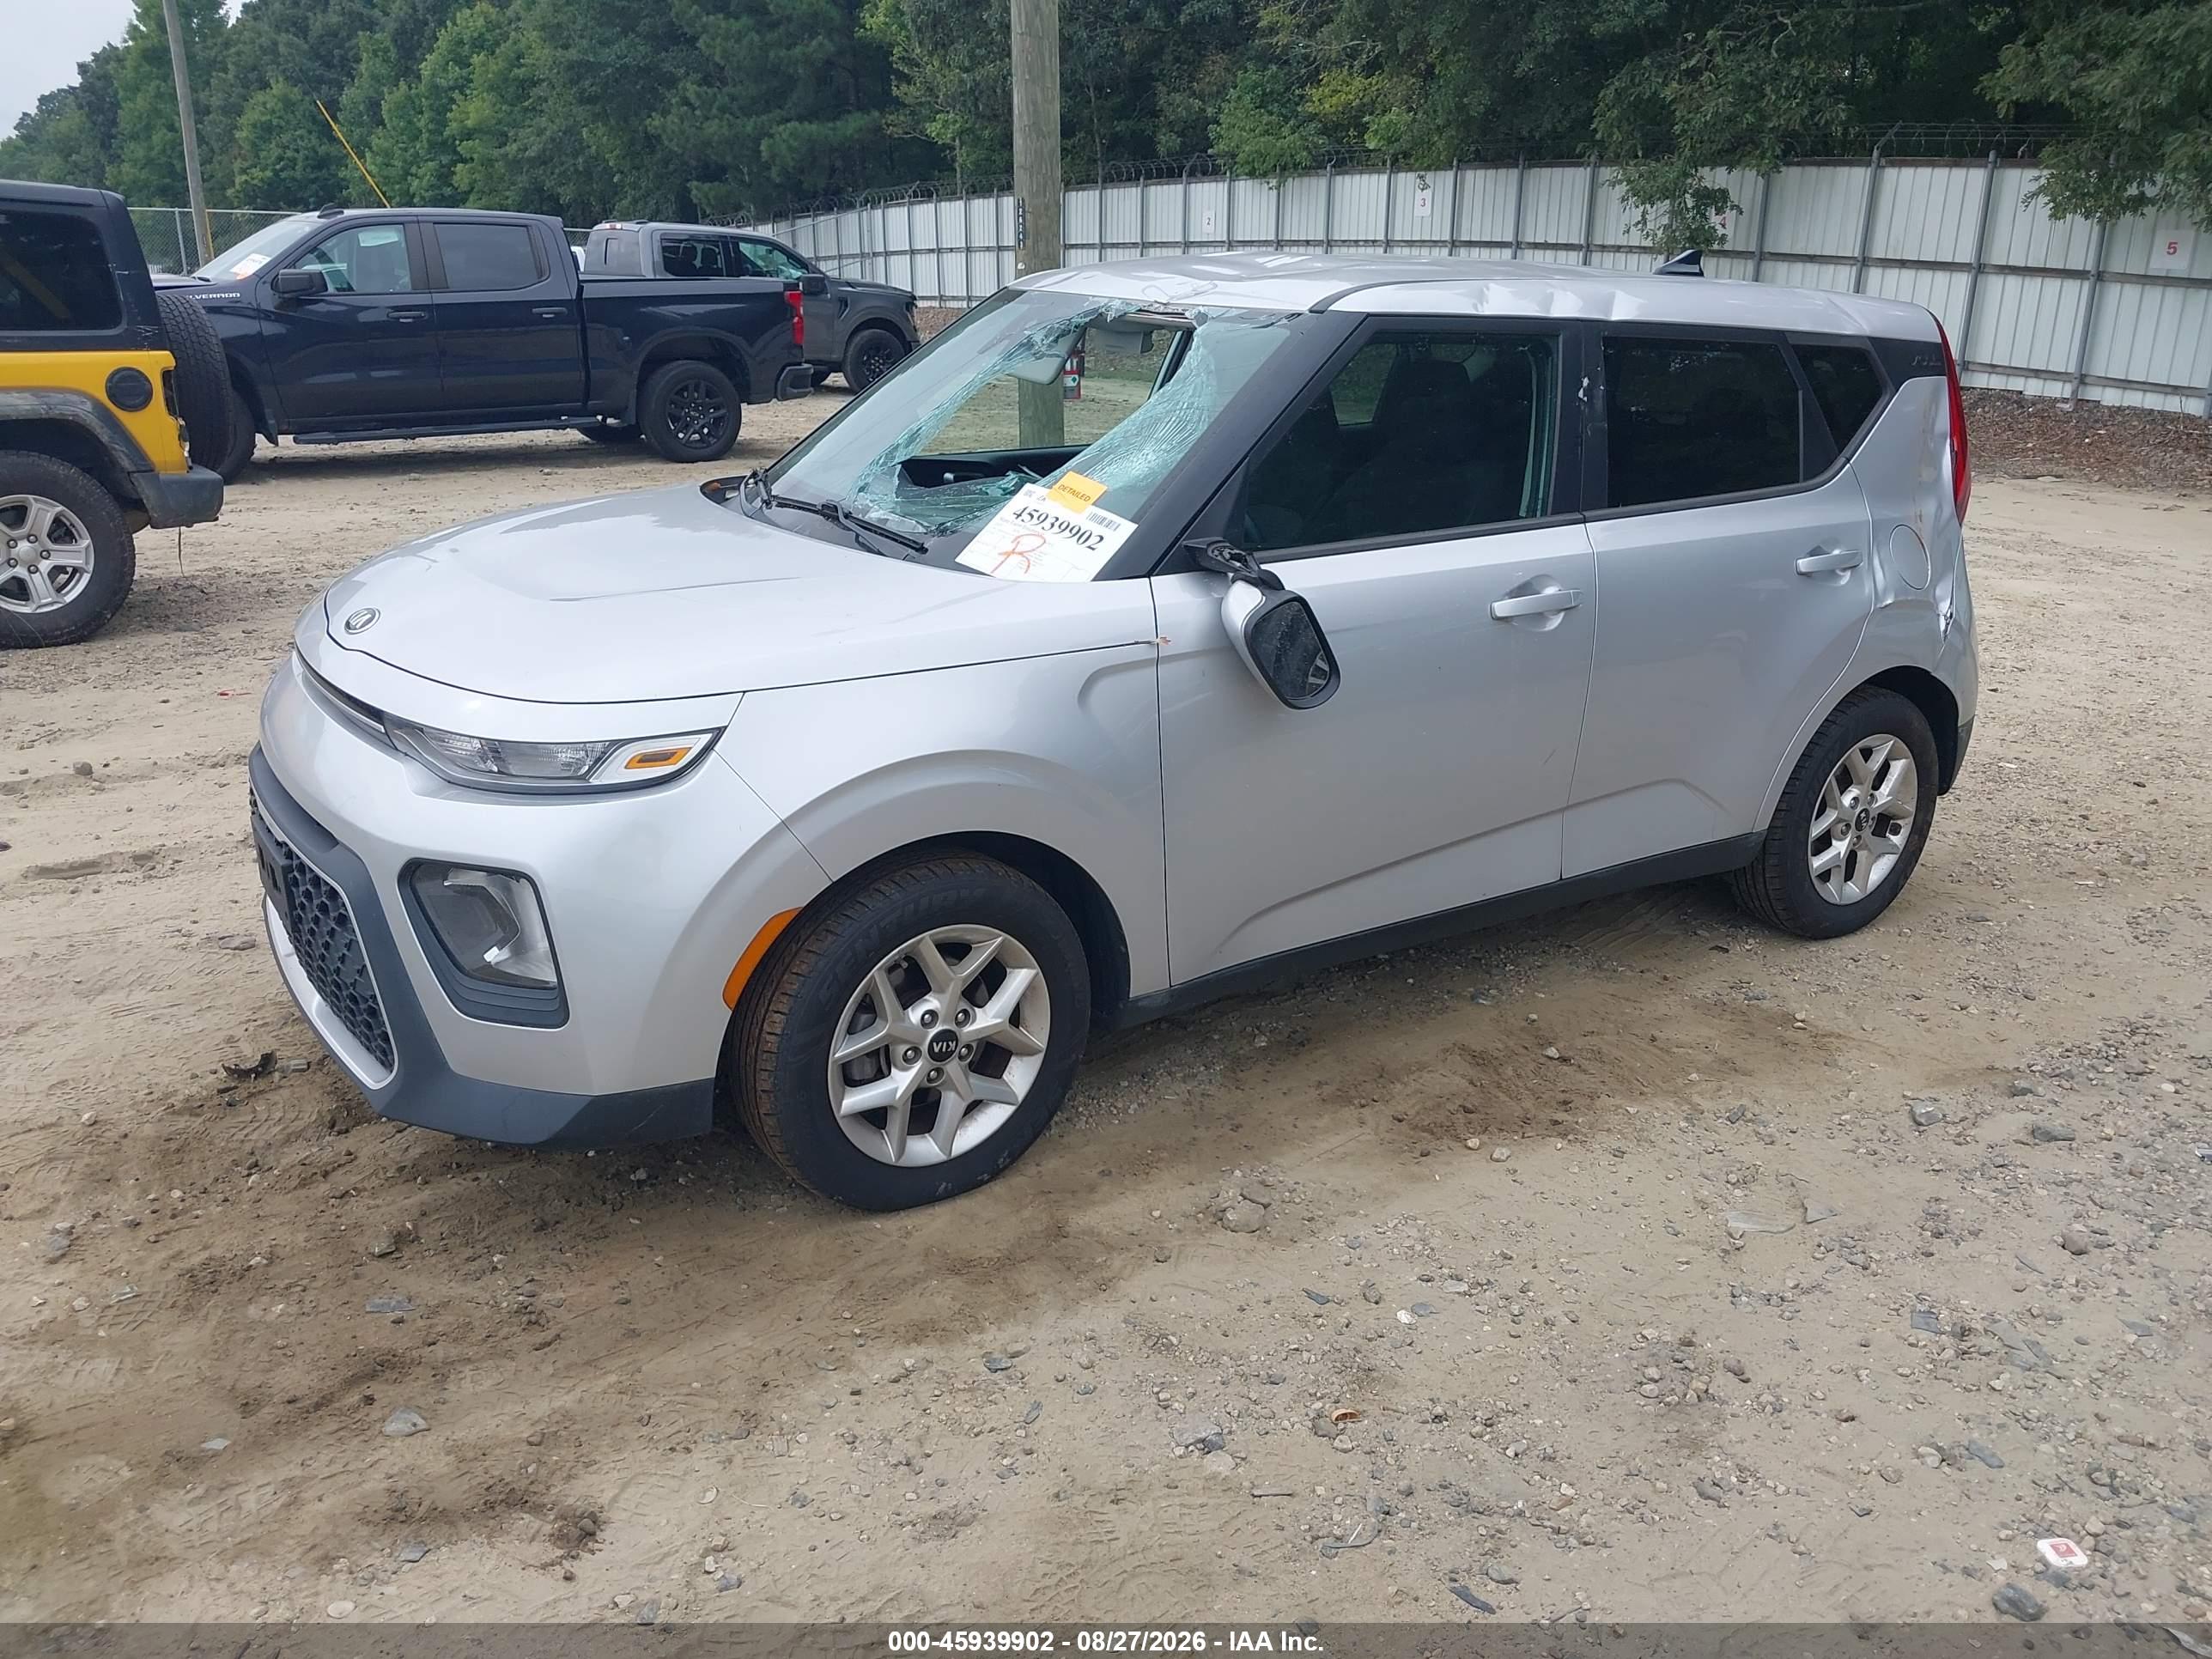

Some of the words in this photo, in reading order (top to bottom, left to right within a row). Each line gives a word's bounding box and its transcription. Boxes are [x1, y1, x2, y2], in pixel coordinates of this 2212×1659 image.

[1420, 198, 1426, 207] 3
[2166, 241, 2179, 255] 5
[1057, 484, 1091, 502] DETAILED
[1013, 505, 1104, 551] 45939902
[933, 1040, 957, 1053] KIA
